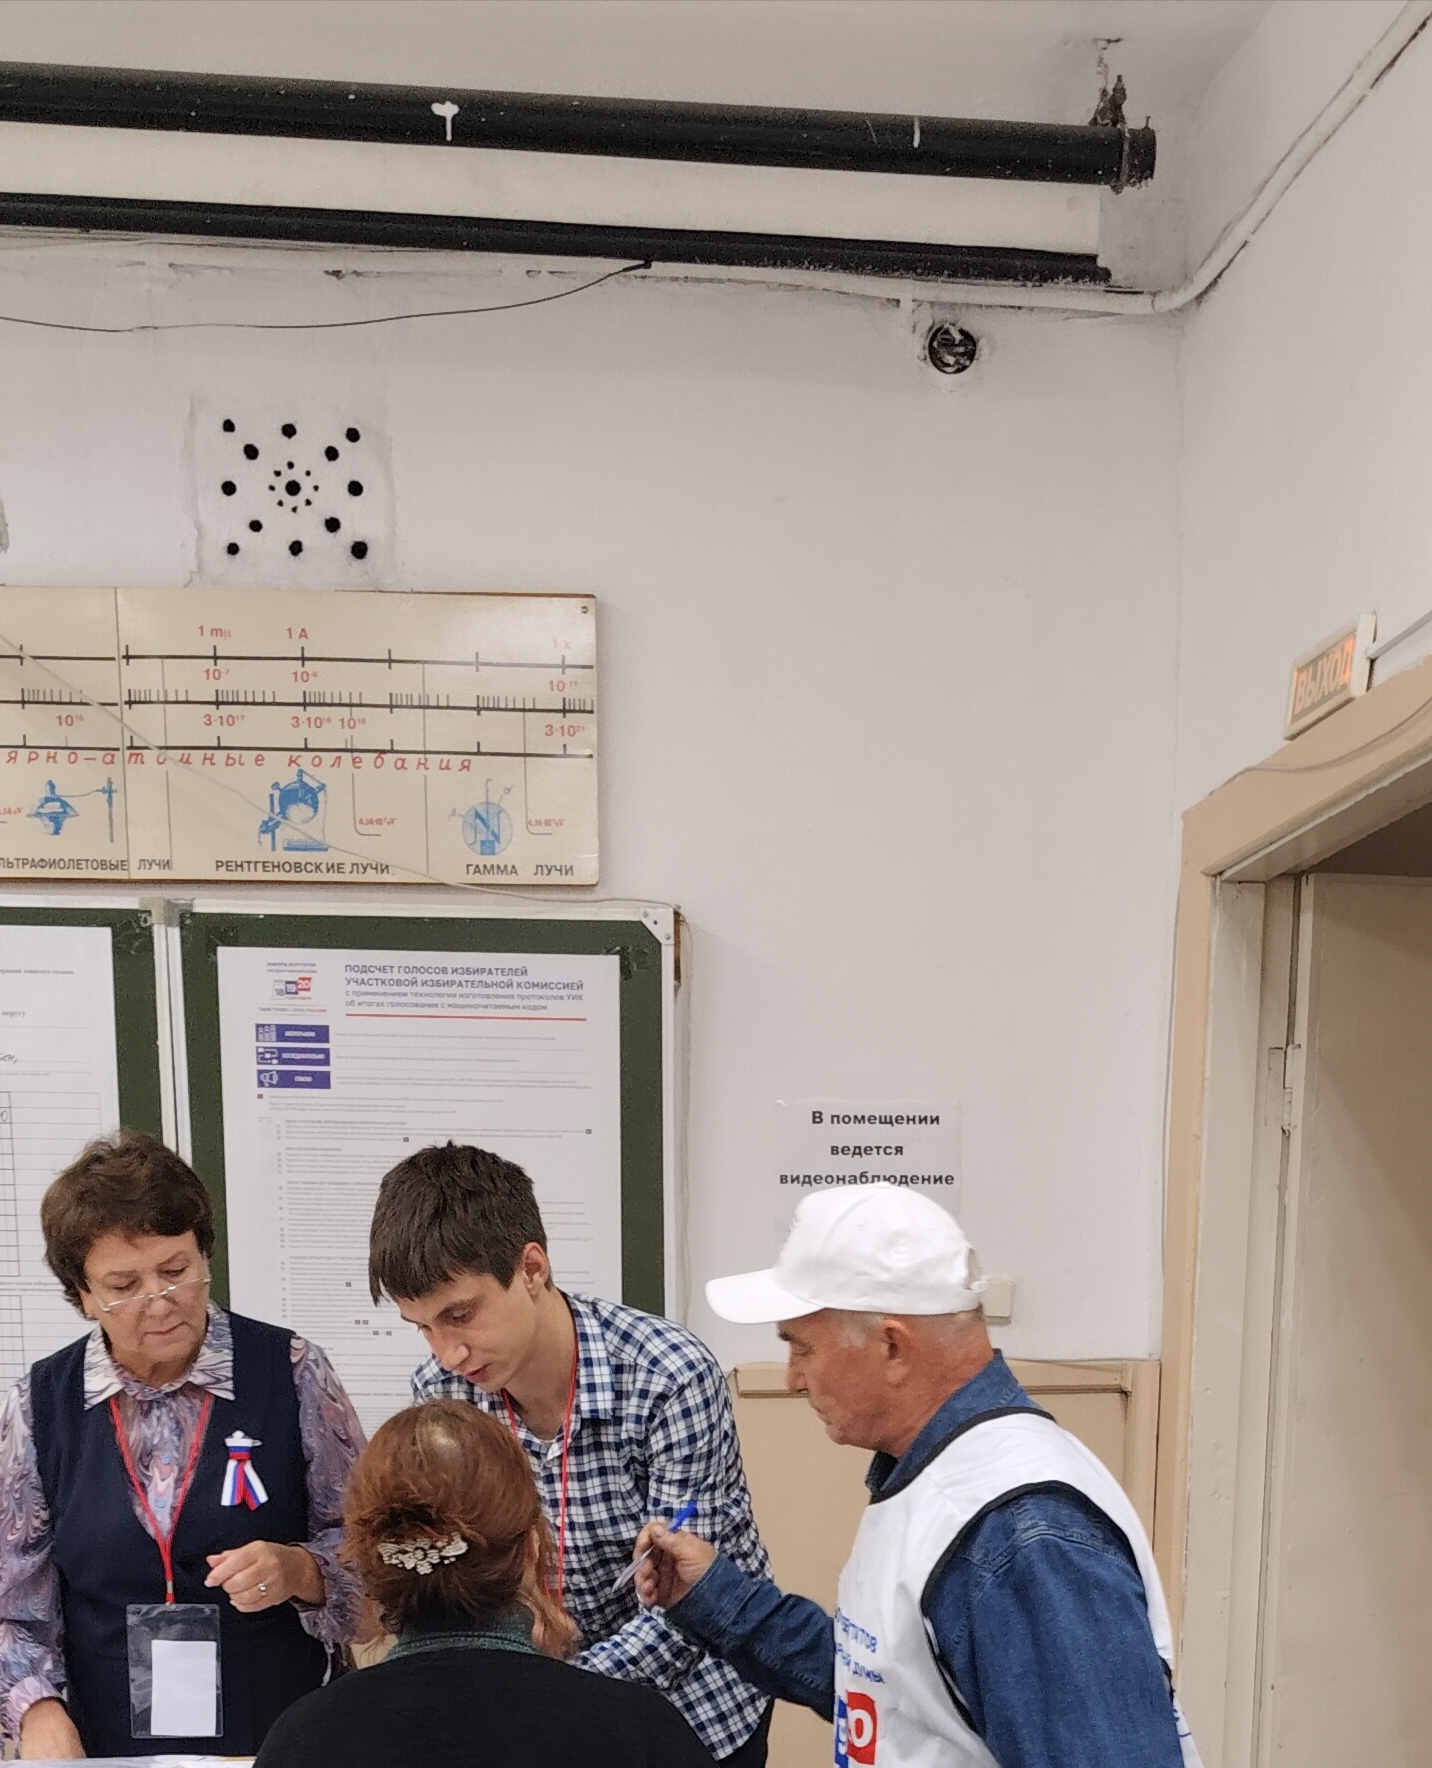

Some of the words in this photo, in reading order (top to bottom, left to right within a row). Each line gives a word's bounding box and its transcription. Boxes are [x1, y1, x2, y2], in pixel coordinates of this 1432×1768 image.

[198, 625, 204, 637] 1
[287, 627, 293, 639] 1
[1294, 638, 1354, 715] ВЫХОД
[287, 751, 472, 772] колебания
[137, 859, 171, 871] ЛУЧИ
[215, 860, 346, 874] РЕНТГЕНОВСКИЕ
[349, 861, 390, 875] ЛУЧИ
[465, 863, 518, 876] ГАММА
[533, 864, 574, 876] ЛУЧИ
[344, 964, 395, 975] ПОДСЧЕТ
[397, 966, 448, 975] ГОЛОСОВ
[451, 966, 528, 977] ИЗБИРАТЕЛЕЙ
[345, 976, 417, 987] УЧАСТКОВОЙ
[421, 978, 513, 989] ИЗБИРАТЕЛЬНОЙ
[516, 980, 584, 991] КОМИССИЕЙ
[812, 1111, 823, 1124] В
[831, 1114, 940, 1127] помещении
[831, 1145, 904, 1158] ведется
[780, 1171, 955, 1187] видеонаблюдение
